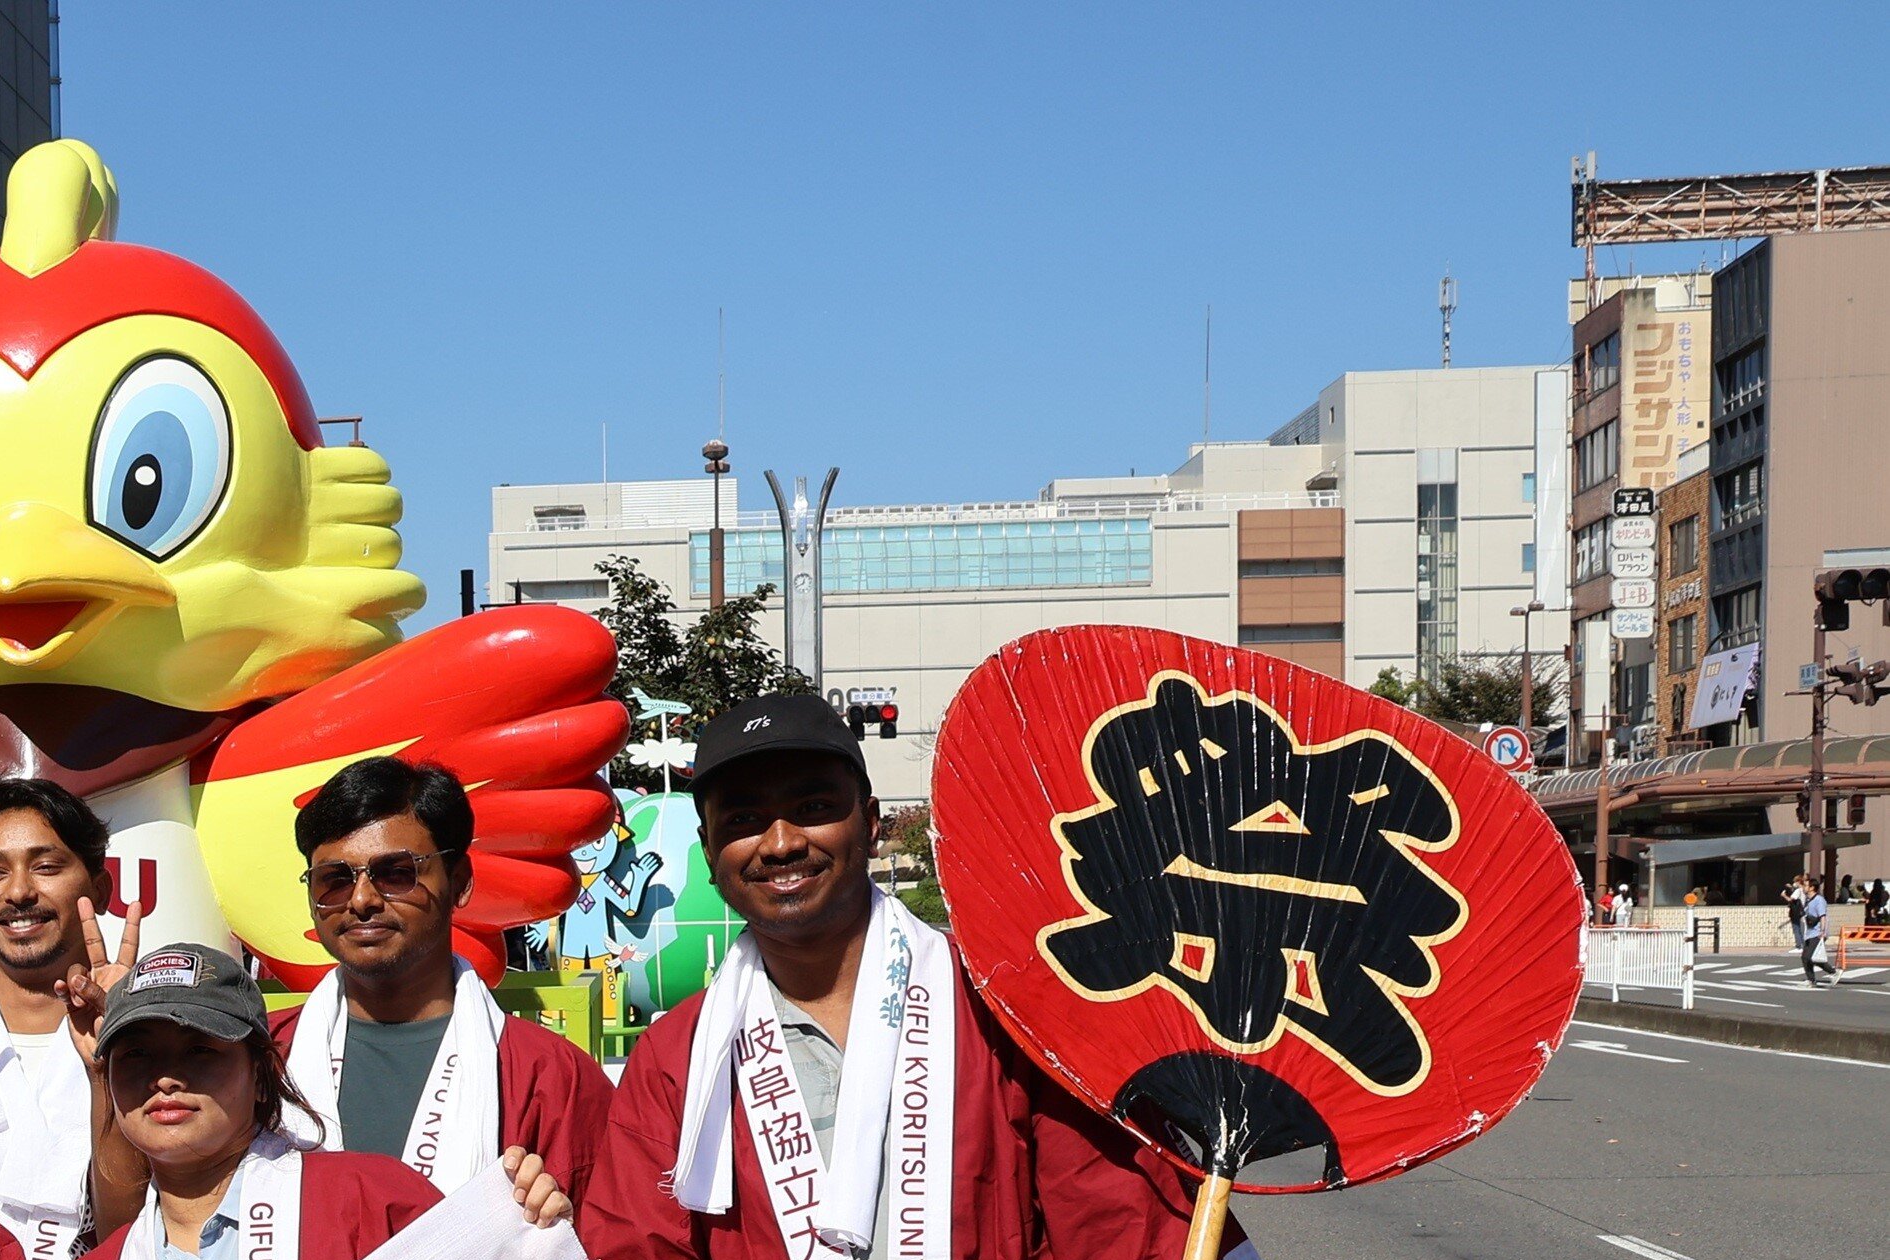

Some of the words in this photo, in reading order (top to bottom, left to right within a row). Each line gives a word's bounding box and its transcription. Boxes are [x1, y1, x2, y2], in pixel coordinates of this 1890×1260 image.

[1616, 527, 1651, 540] キリンビール
[1617, 553, 1648, 562] ロバート
[1617, 613, 1649, 622] サントリー
[743, 715, 772, 733] 87's
[143, 957, 187, 970] DICKIES
[149, 969, 177, 978] TEXAS
[905, 984, 930, 1045] GIFU
[900, 1057, 928, 1196] KYORITSU
